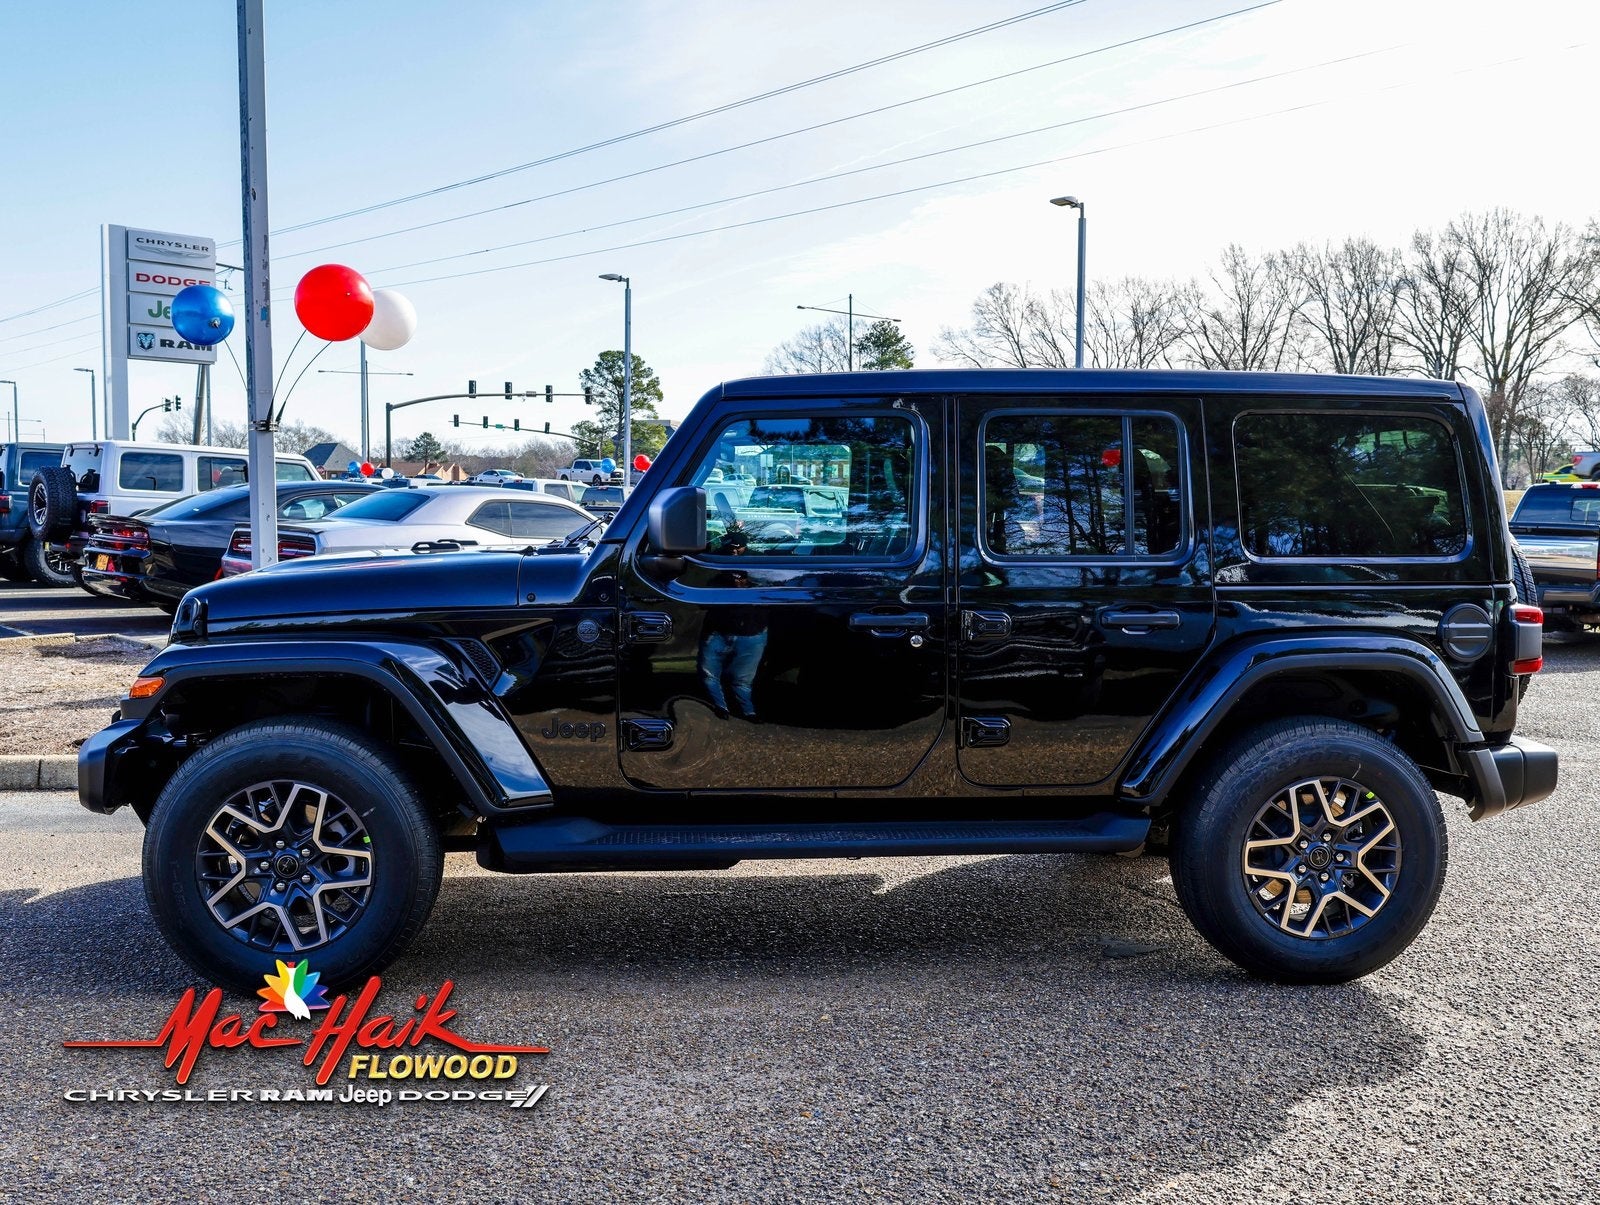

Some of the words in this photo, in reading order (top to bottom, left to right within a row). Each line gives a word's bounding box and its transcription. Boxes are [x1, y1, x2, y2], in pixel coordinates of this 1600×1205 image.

[135, 237, 209, 252] CHRYSLER
[147, 300, 171, 320] Je
[541, 716, 607, 743] Jeep
